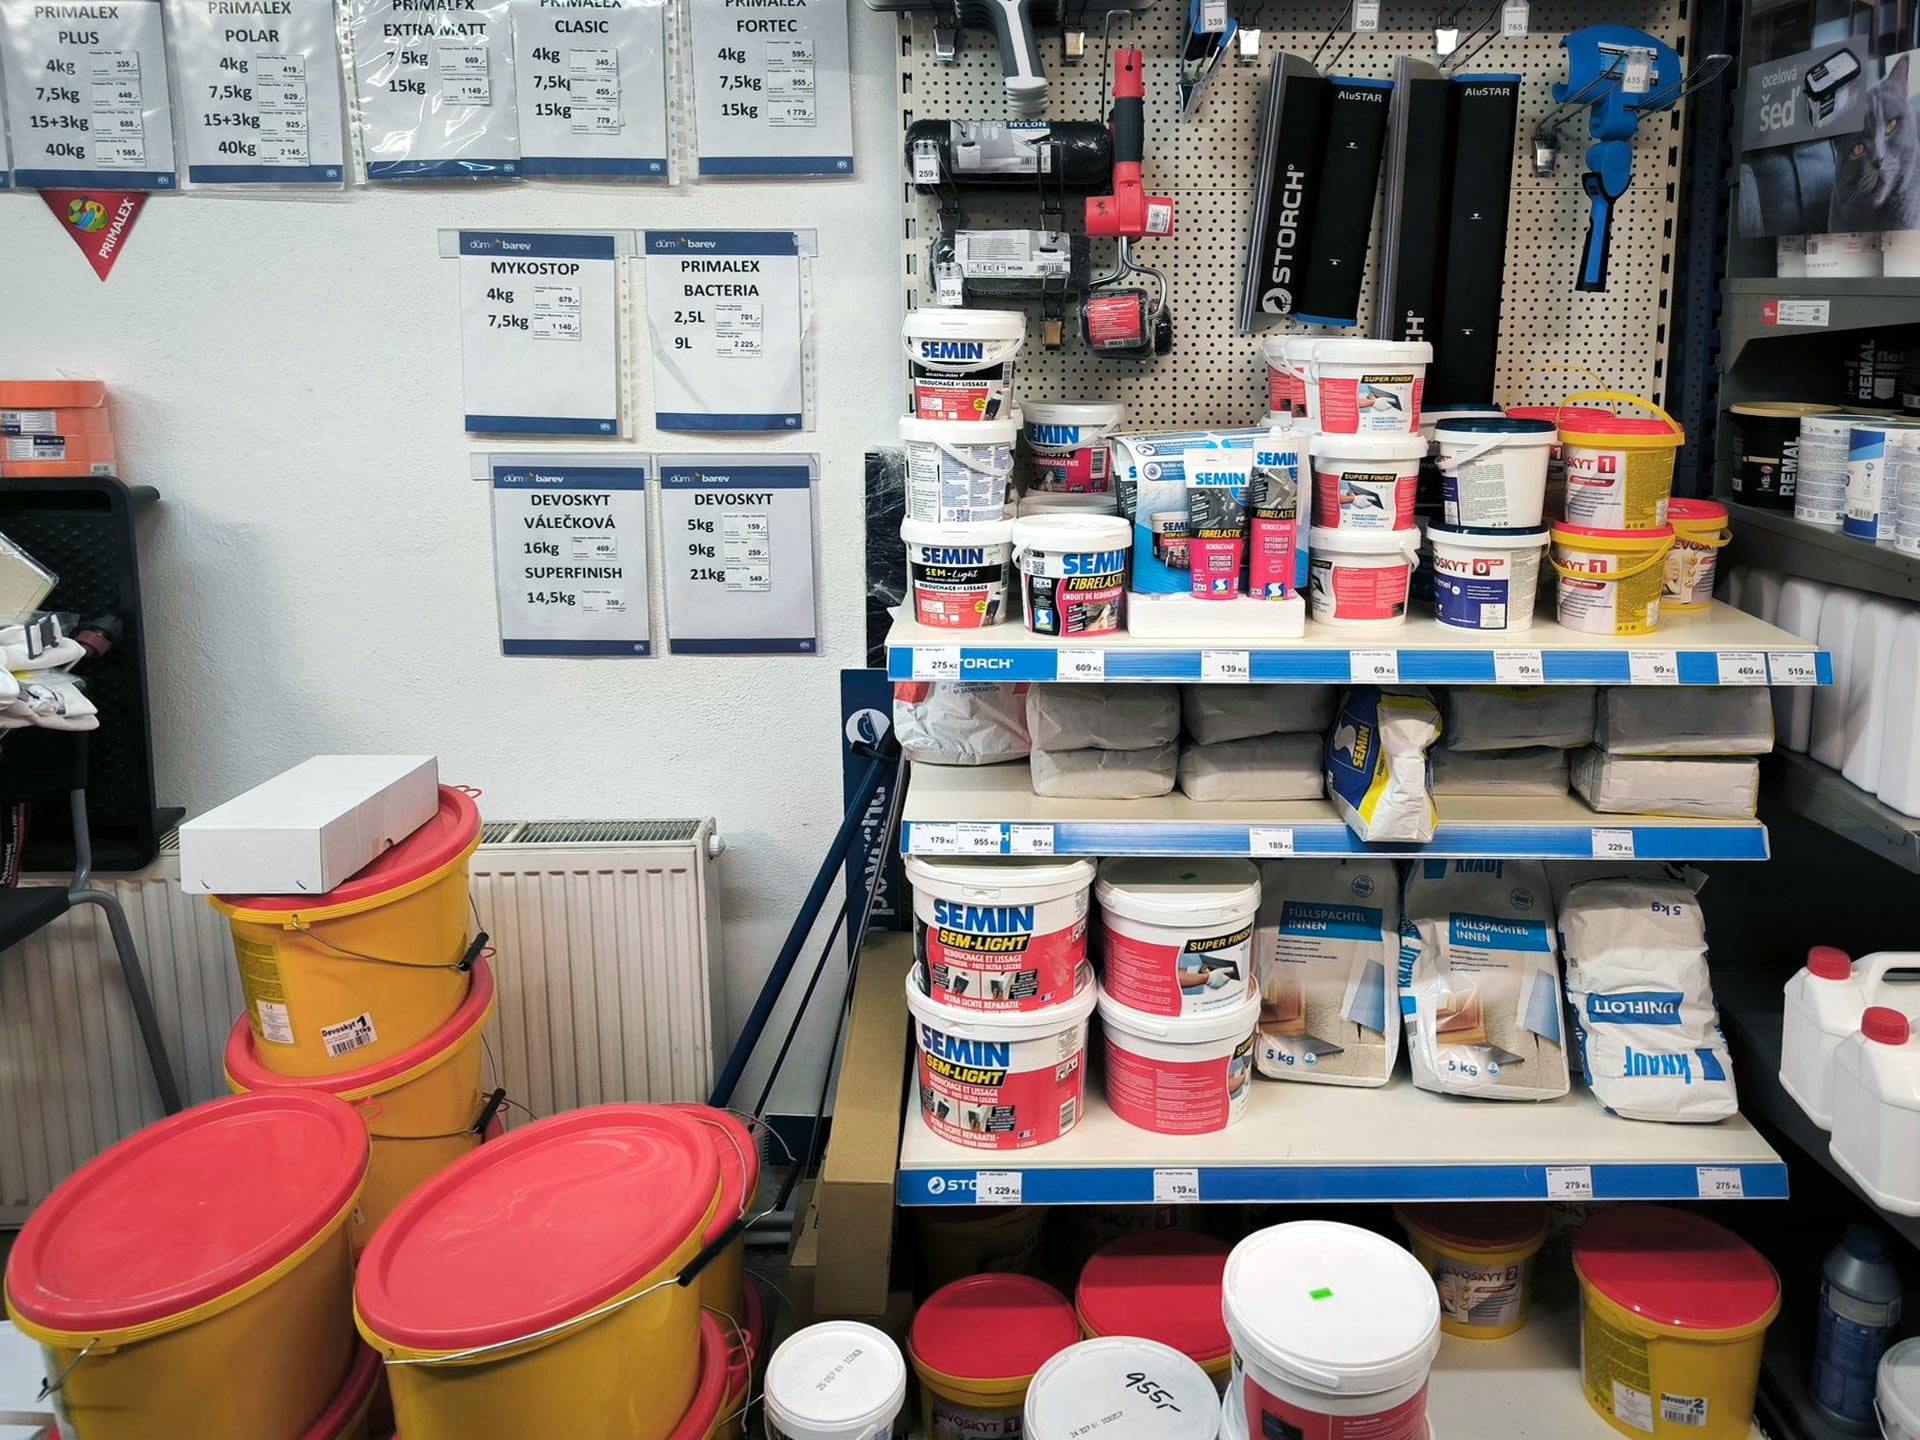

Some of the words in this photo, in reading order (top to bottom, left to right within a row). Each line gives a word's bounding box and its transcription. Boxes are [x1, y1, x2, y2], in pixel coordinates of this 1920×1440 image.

[35, 5, 119, 19] PRIMALEX
[208, 1, 292, 15] PRIMALEX
[393, 0, 475, 10] PRIMALEX
[555, 20, 609, 33] CLASIC
[737, 20, 797, 32] FORTEC
[1207, 18, 1223, 26] 339
[1359, 19, 1375, 27] 509
[225, 29, 279, 43] POLAR
[384, 23, 434, 36] EXTRA
[440, 23, 486, 35] MATT
[59, 31, 99, 45] PLUS
[532, 48, 560, 63] 4kg
[718, 48, 746, 63] 4kg
[46, 59, 75, 75] 4kg
[219, 57, 248, 73] 4kg
[719, 76, 761, 90] 7,5kg
[1762, 64, 1798, 88] ocelová
[209, 85, 253, 101] 7,5kg
[389, 80, 426, 95] 15kg
[1465, 88, 1510, 96] AluSTAR
[35, 87, 80, 103] 7,5kg
[1338, 90, 1382, 102] AluSTAR
[535, 103, 571, 118] 15kg
[722, 104, 758, 118] 15kg
[1759, 85, 1800, 132] šeď
[31, 114, 89, 131] 15+3kg
[204, 113, 260, 129] 15+3kg
[45, 143, 86, 159] 40kg
[218, 140, 257, 156] 40kg
[918, 170, 934, 178] 259
[98, 199, 135, 259] PRIMALEX
[1272, 171, 1305, 284] STORCH
[470, 239, 490, 250] dům
[503, 240, 531, 251] barev
[656, 239, 676, 248] dům
[688, 239, 716, 250] barev
[490, 262, 580, 276] MYKOSTOP
[681, 260, 760, 273] PRIMALEX
[487, 287, 514, 303] 4kg
[684, 284, 760, 297] BACTERIA
[941, 289, 956, 298] 269
[488, 314, 529, 330] 7,5kg
[674, 310, 705, 325] 2,5L
[674, 337, 692, 350] 9L
[921, 341, 983, 360] SEMIN
[1859, 339, 1875, 400] REMAL
[1257, 452, 1297, 465] SEMIN
[1780, 436, 1800, 496] REMAL
[504, 474, 524, 483] dům
[536, 475, 563, 484] barev
[670, 474, 691, 483] dům
[702, 474, 730, 484] barev
[1195, 473, 1246, 485] SEMIN
[531, 494, 611, 506] DEVOSKYT
[694, 493, 773, 505] DEVOSKYT
[524, 515, 616, 529] VÁLEČKOVÁ
[688, 519, 714, 533] 5kg
[524, 542, 559, 557] 16kg
[688, 544, 715, 559] 9kg
[922, 547, 983, 564] SEMIN
[1063, 552, 1125, 575] SEMIN
[525, 567, 622, 579] SUPERFINISH
[690, 569, 725, 583] 21kg
[527, 591, 576, 606] 14,5kg
[961, 658, 1010, 668] ORCH
[1374, 666, 1385, 674] 69
[1352, 725, 1369, 767] SEMIN
[931, 836, 945, 844] 179
[974, 838, 989, 846] 955
[1033, 839, 1042, 847] 89
[1289, 907, 1366, 922] FÜLLSPACHTEL
[1651, 901, 1669, 915] kg
[1673, 906, 1681, 915] 5
[934, 898, 1034, 933] SEMIN
[1289, 921, 1326, 930] INNEN
[1455, 917, 1528, 935] FÜLLSPACHTEL
[939, 931, 1028, 950] SEM-LIGHT
[1456, 931, 1490, 943] INNEN
[1190, 939, 1225, 951] SUPER
[994, 954, 1022, 962] LISSAGE
[1594, 1000, 1674, 1014] UNIFLOTT
[322, 1021, 356, 1038] Devoskyt
[357, 1016, 367, 1028] 1
[922, 1024, 1010, 1067] SEMIN
[1266, 1050, 1275, 1060] 5
[1278, 1051, 1294, 1066] kg
[1624, 1045, 1691, 1084] KNAUF
[926, 1055, 1003, 1085] SEM-LIGHT
[1448, 1060, 1457, 1070] 5
[1460, 1060, 1477, 1076] kg
[971, 1088, 997, 1097] LISSAGE
[995, 1187, 1010, 1195] 229
[1172, 1186, 1187, 1194] 139
[1565, 1181, 1581, 1189] 279
[1715, 1181, 1730, 1189] 275
[1661, 1393, 1693, 1406] Devoskyt
[1694, 1399, 1704, 1408] 2
